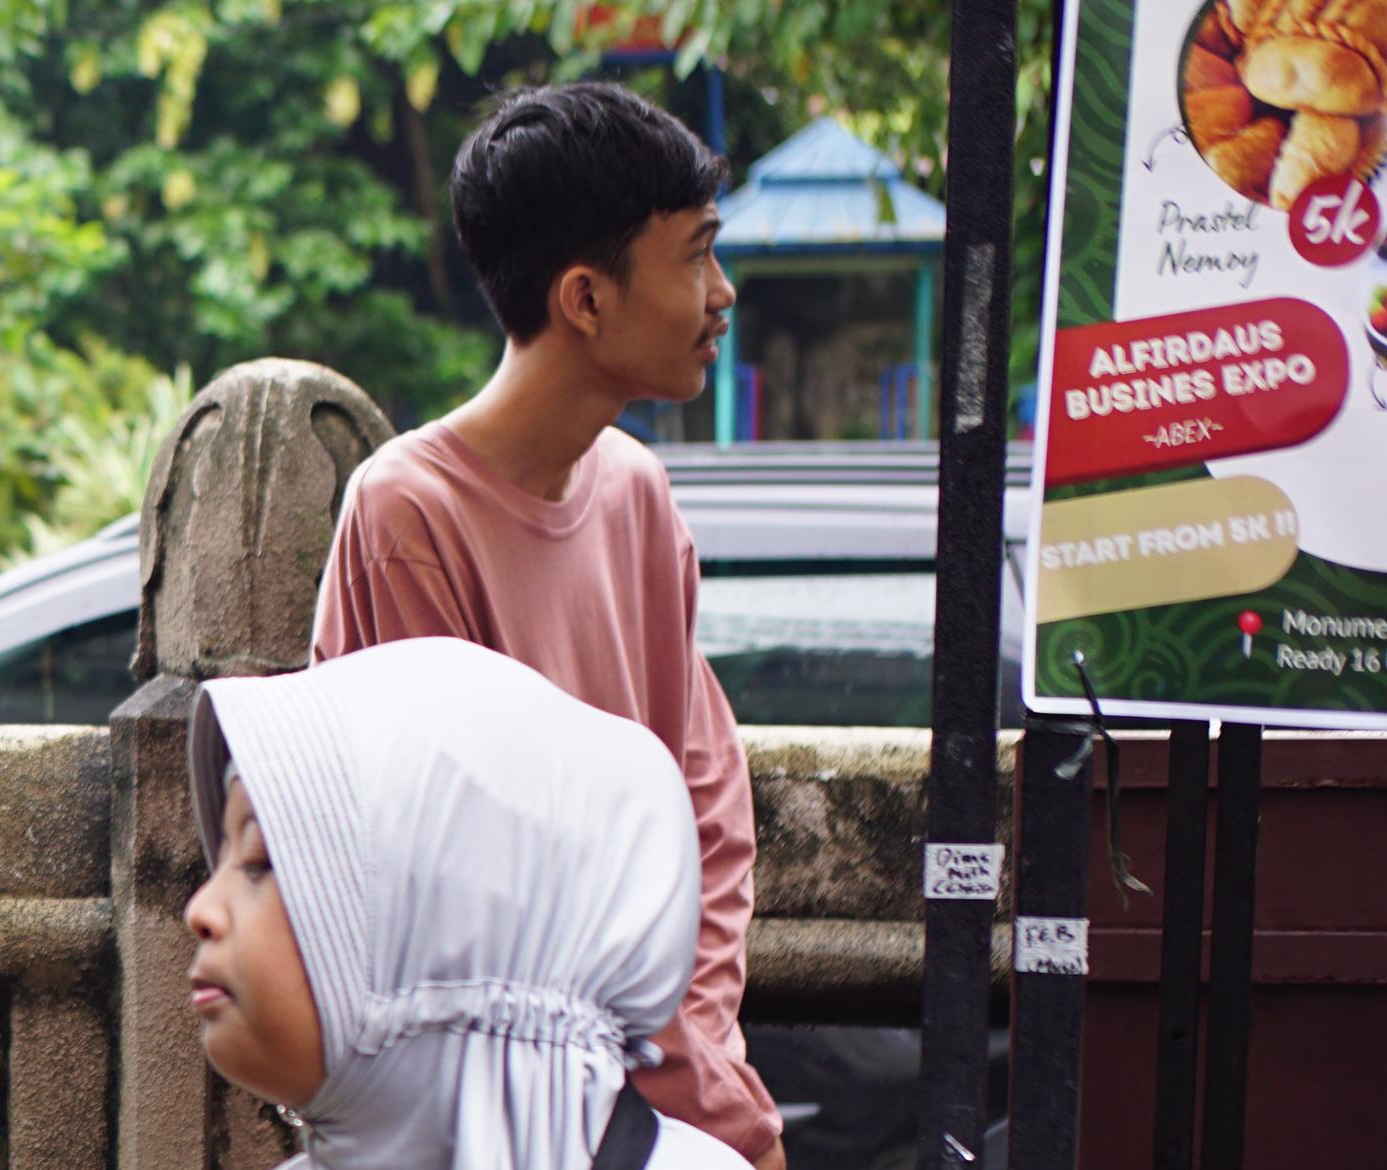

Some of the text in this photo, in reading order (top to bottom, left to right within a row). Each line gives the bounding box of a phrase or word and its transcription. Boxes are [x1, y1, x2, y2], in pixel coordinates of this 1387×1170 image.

[1156, 198, 1263, 234] Prastel
[1302, 178, 1370, 245] 5k
[1089, 319, 1285, 379] ALFIRDAUS
[1065, 353, 1317, 421] BUSINES EXPO
[1040, 533, 1133, 571] START
[1137, 520, 1224, 558] FROM
[1230, 513, 1271, 543] 5K
[1277, 643, 1381, 677] Ready 16
